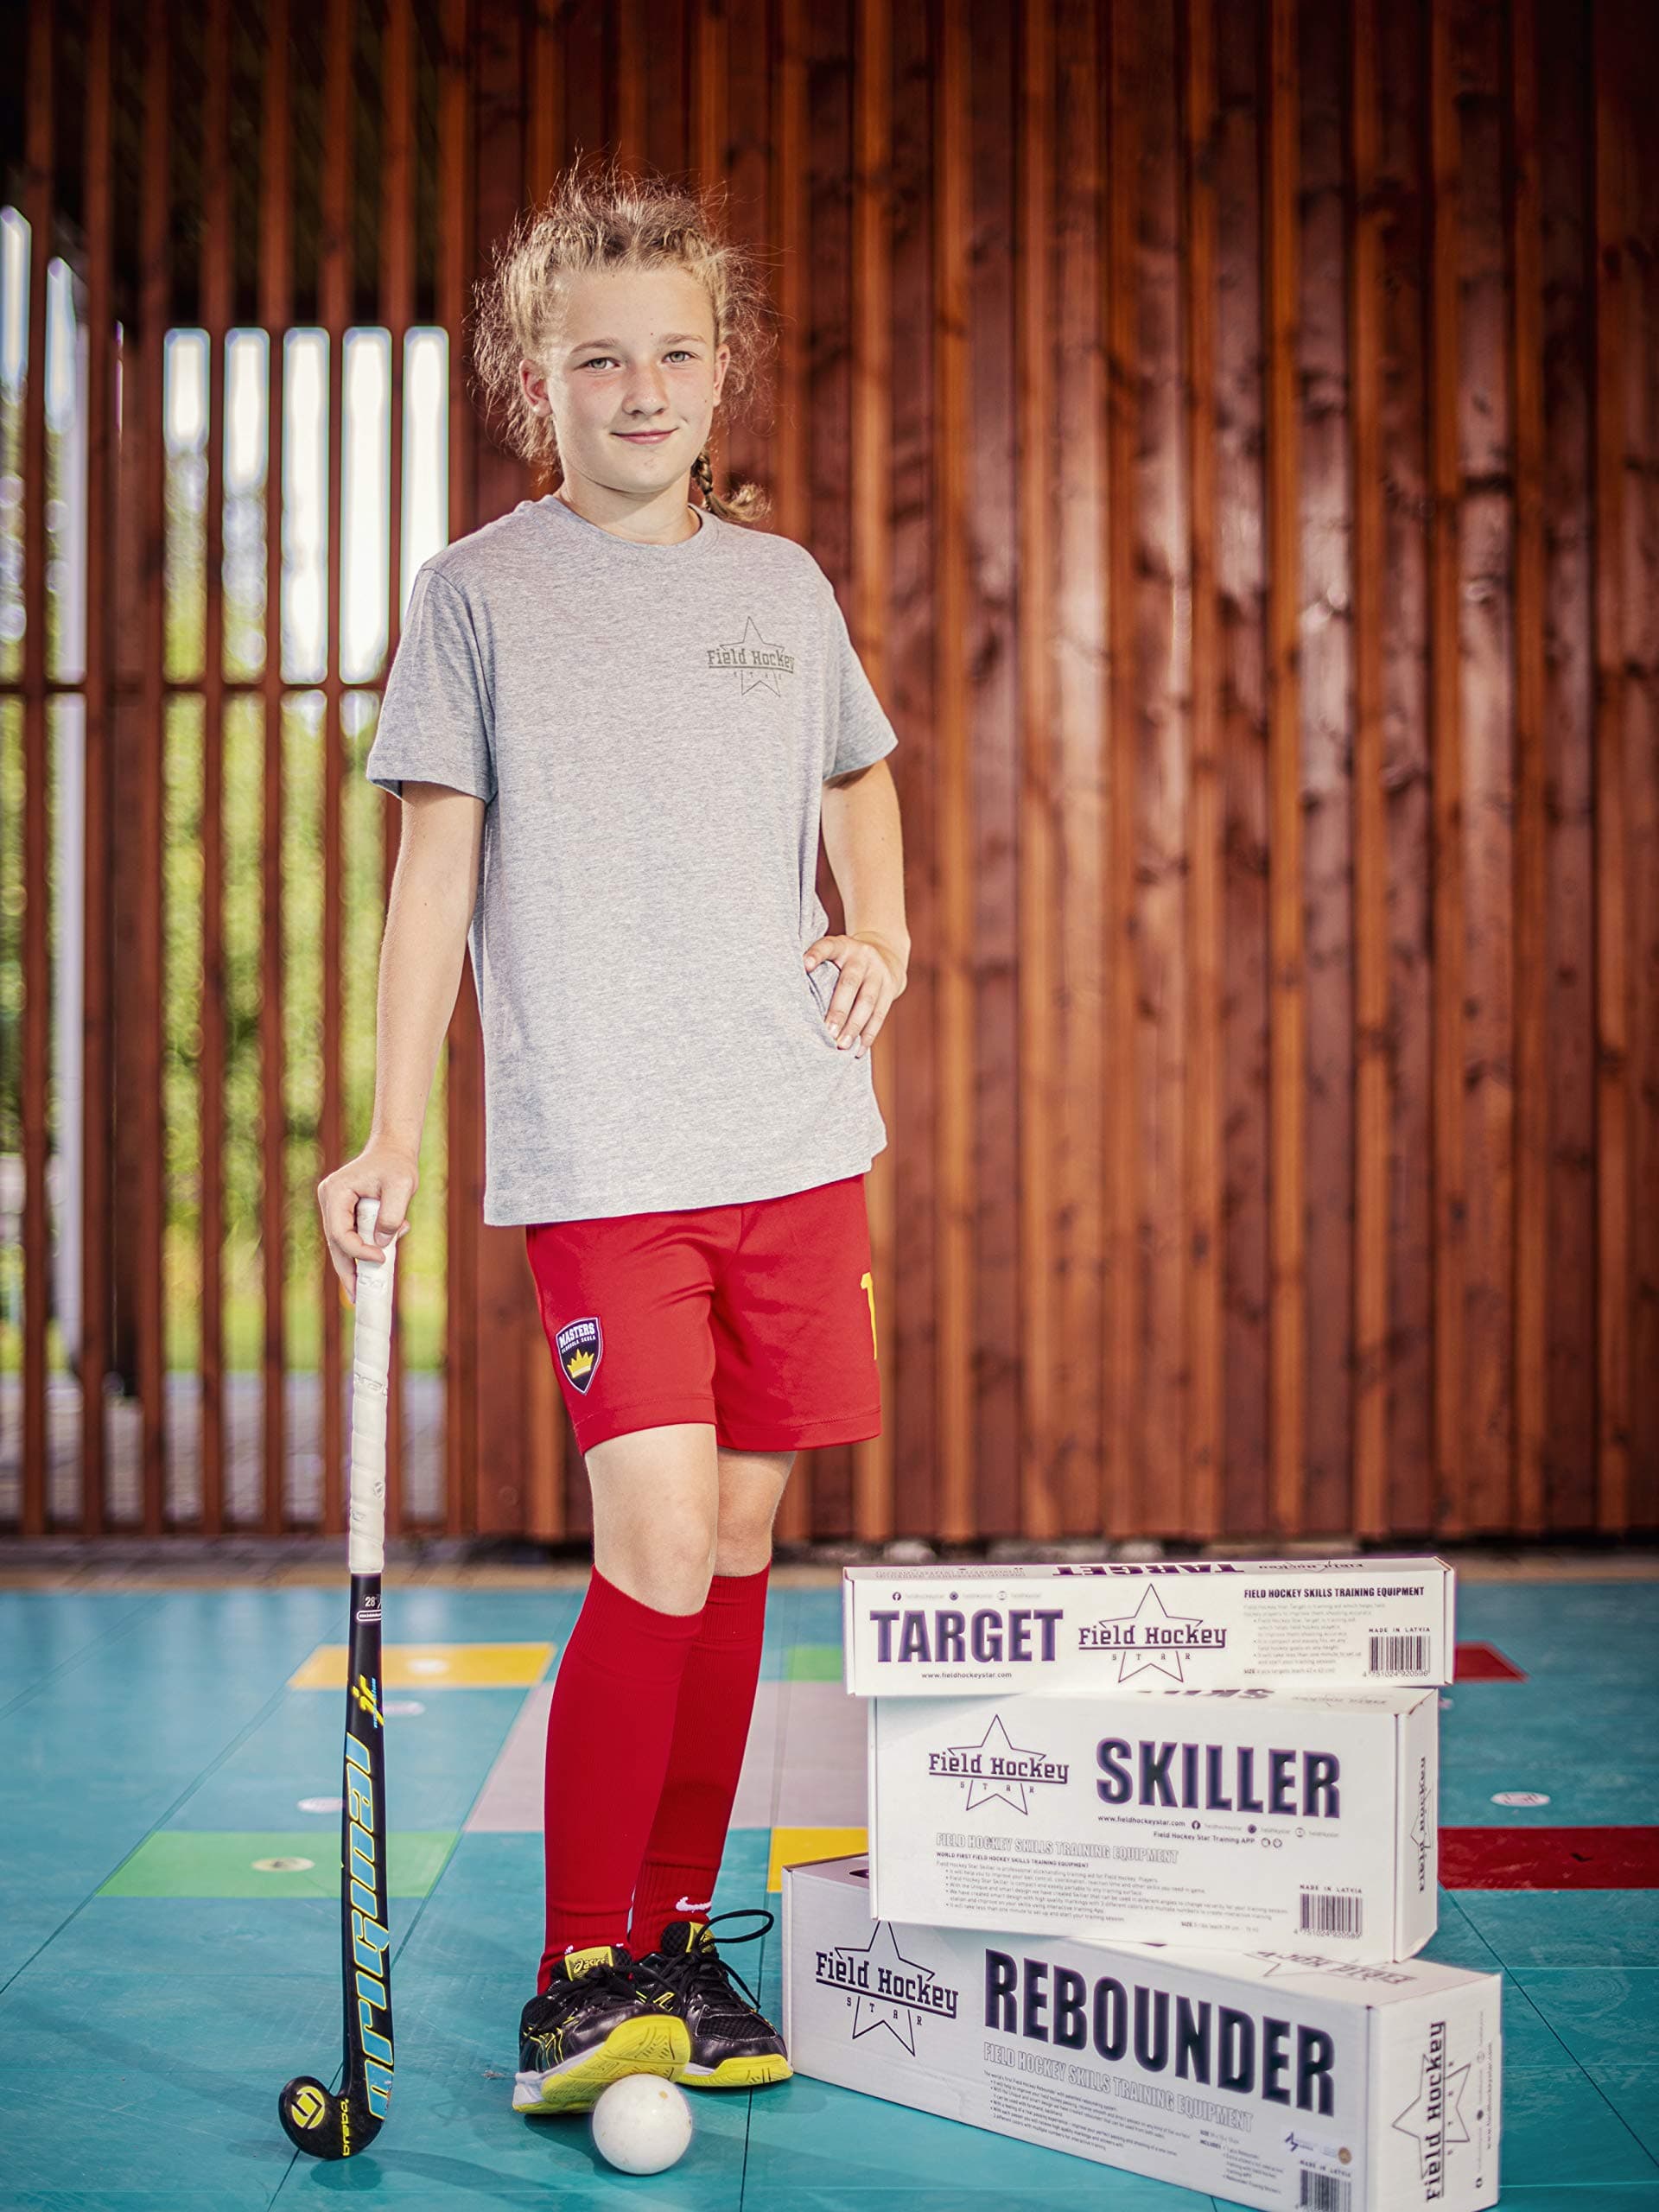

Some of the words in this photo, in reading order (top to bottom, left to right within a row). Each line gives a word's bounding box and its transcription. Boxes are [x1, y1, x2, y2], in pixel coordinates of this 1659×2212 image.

[706, 648, 747, 664] Field
[751, 650, 795, 671] Hockey
[558, 1322, 595, 1348] MASTERS
[1243, 1589, 1266, 1599] FIELD
[1268, 1588, 1301, 1598] HOCKEY
[1303, 1588, 1332, 1598] SKILLS
[1335, 1587, 1375, 1597] TRAINING
[1376, 1586, 1425, 1597] EQUIPMENT
[869, 1608, 1064, 1662] TARGET
[1078, 1625, 1135, 1645] Field
[1145, 1624, 1227, 1648] Hockey
[921, 1671, 1012, 1680] www.fieldhockeystar.com
[929, 1752, 982, 1773] Field
[990, 1757, 1069, 1782] Hockey
[1096, 1737, 1340, 1818] SKILLER
[1097, 1815, 1185, 1827] www.fieldhockeystar.com
[936, 1833, 965, 1847] FIELD
[968, 1834, 1013, 1852] HOCKEY
[1014, 1838, 1054, 1854] SKILLS
[1055, 1841, 1110, 1859] TRAINING
[1112, 1846, 1179, 1864] EQUIPMENT
[1172, 1832, 1195, 1840] Hockey
[1213, 1834, 1240, 1844] Training
[816, 1949, 868, 1989] Field
[877, 1967, 958, 2015] Hockey
[984, 1948, 1336, 2117] REBOUNDER
[1425, 2021, 1446, 2121] Hockey
[983, 2041, 1014, 2067] FIELD
[1018, 2050, 1066, 2082] HOCKEY
[1068, 2063, 1111, 2094] SKILLS
[1113, 2075, 1174, 2110] TRAINING
[1174, 2094, 1253, 2133] EQUIPMENT
[1424, 2132, 1441, 2202] Field
